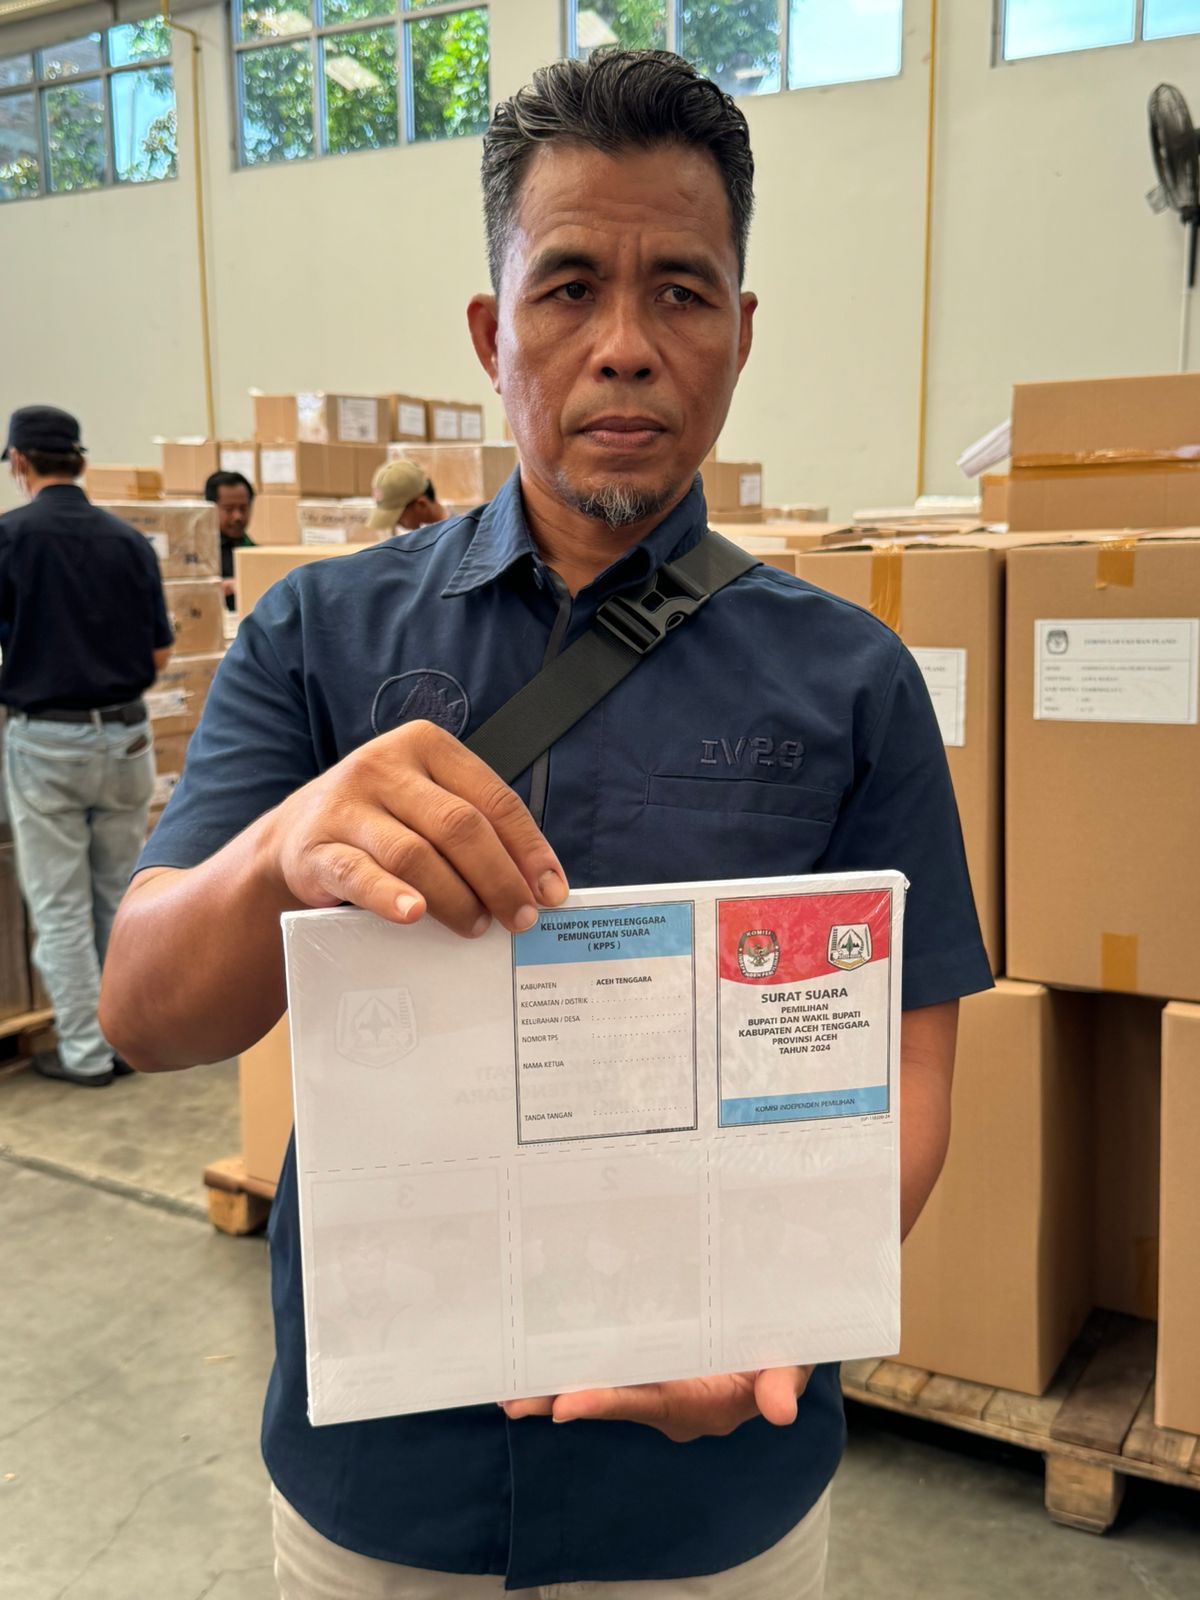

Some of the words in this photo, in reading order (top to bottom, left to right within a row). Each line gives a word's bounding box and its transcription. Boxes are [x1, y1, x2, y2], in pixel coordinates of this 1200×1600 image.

[540, 920, 590, 932] KELOMPOK
[592, 916, 667, 929] PENYELENGGARA
[557, 930, 619, 942] PEMUNGUTAN
[620, 928, 651, 938] SUARA
[593, 941, 616, 950] KPPS
[520, 982, 558, 990] KABUPATEN
[596, 978, 615, 986] ACEH
[615, 976, 653, 984] TENGGARA
[760, 991, 802, 1004] SURAT
[805, 988, 848, 1000] SUARA
[520, 999, 560, 1008] KECAMATAN
[781, 1003, 829, 1014] PEMILIHAN
[521, 1016, 559, 1026] KELURAHAN
[748, 1018, 778, 1026] BUPATI
[780, 1016, 800, 1024] DAN
[802, 1014, 830, 1022] WAKIL
[832, 1010, 861, 1020] BUPATI
[738, 1026, 792, 1038] KABUPATEN
[794, 1024, 819, 1034] ACEH
[821, 1020, 870, 1032] TENGGARA
[522, 1035, 548, 1043] NOMOR
[772, 1035, 812, 1046] PROVINSI
[815, 1034, 838, 1042] ACEH
[779, 1045, 808, 1055] TAHUN
[810, 1044, 831, 1053] 2024
[522, 1062, 543, 1070] NAMA
[544, 1060, 565, 1068] KETUA
[755, 1104, 778, 1113] KOMISI
[780, 1101, 820, 1111] INDEPENDEN
[820, 1098, 856, 1108] PEMILIHAN
[524, 1113, 546, 1122] TANDA
[547, 1111, 573, 1120] TANGAN
